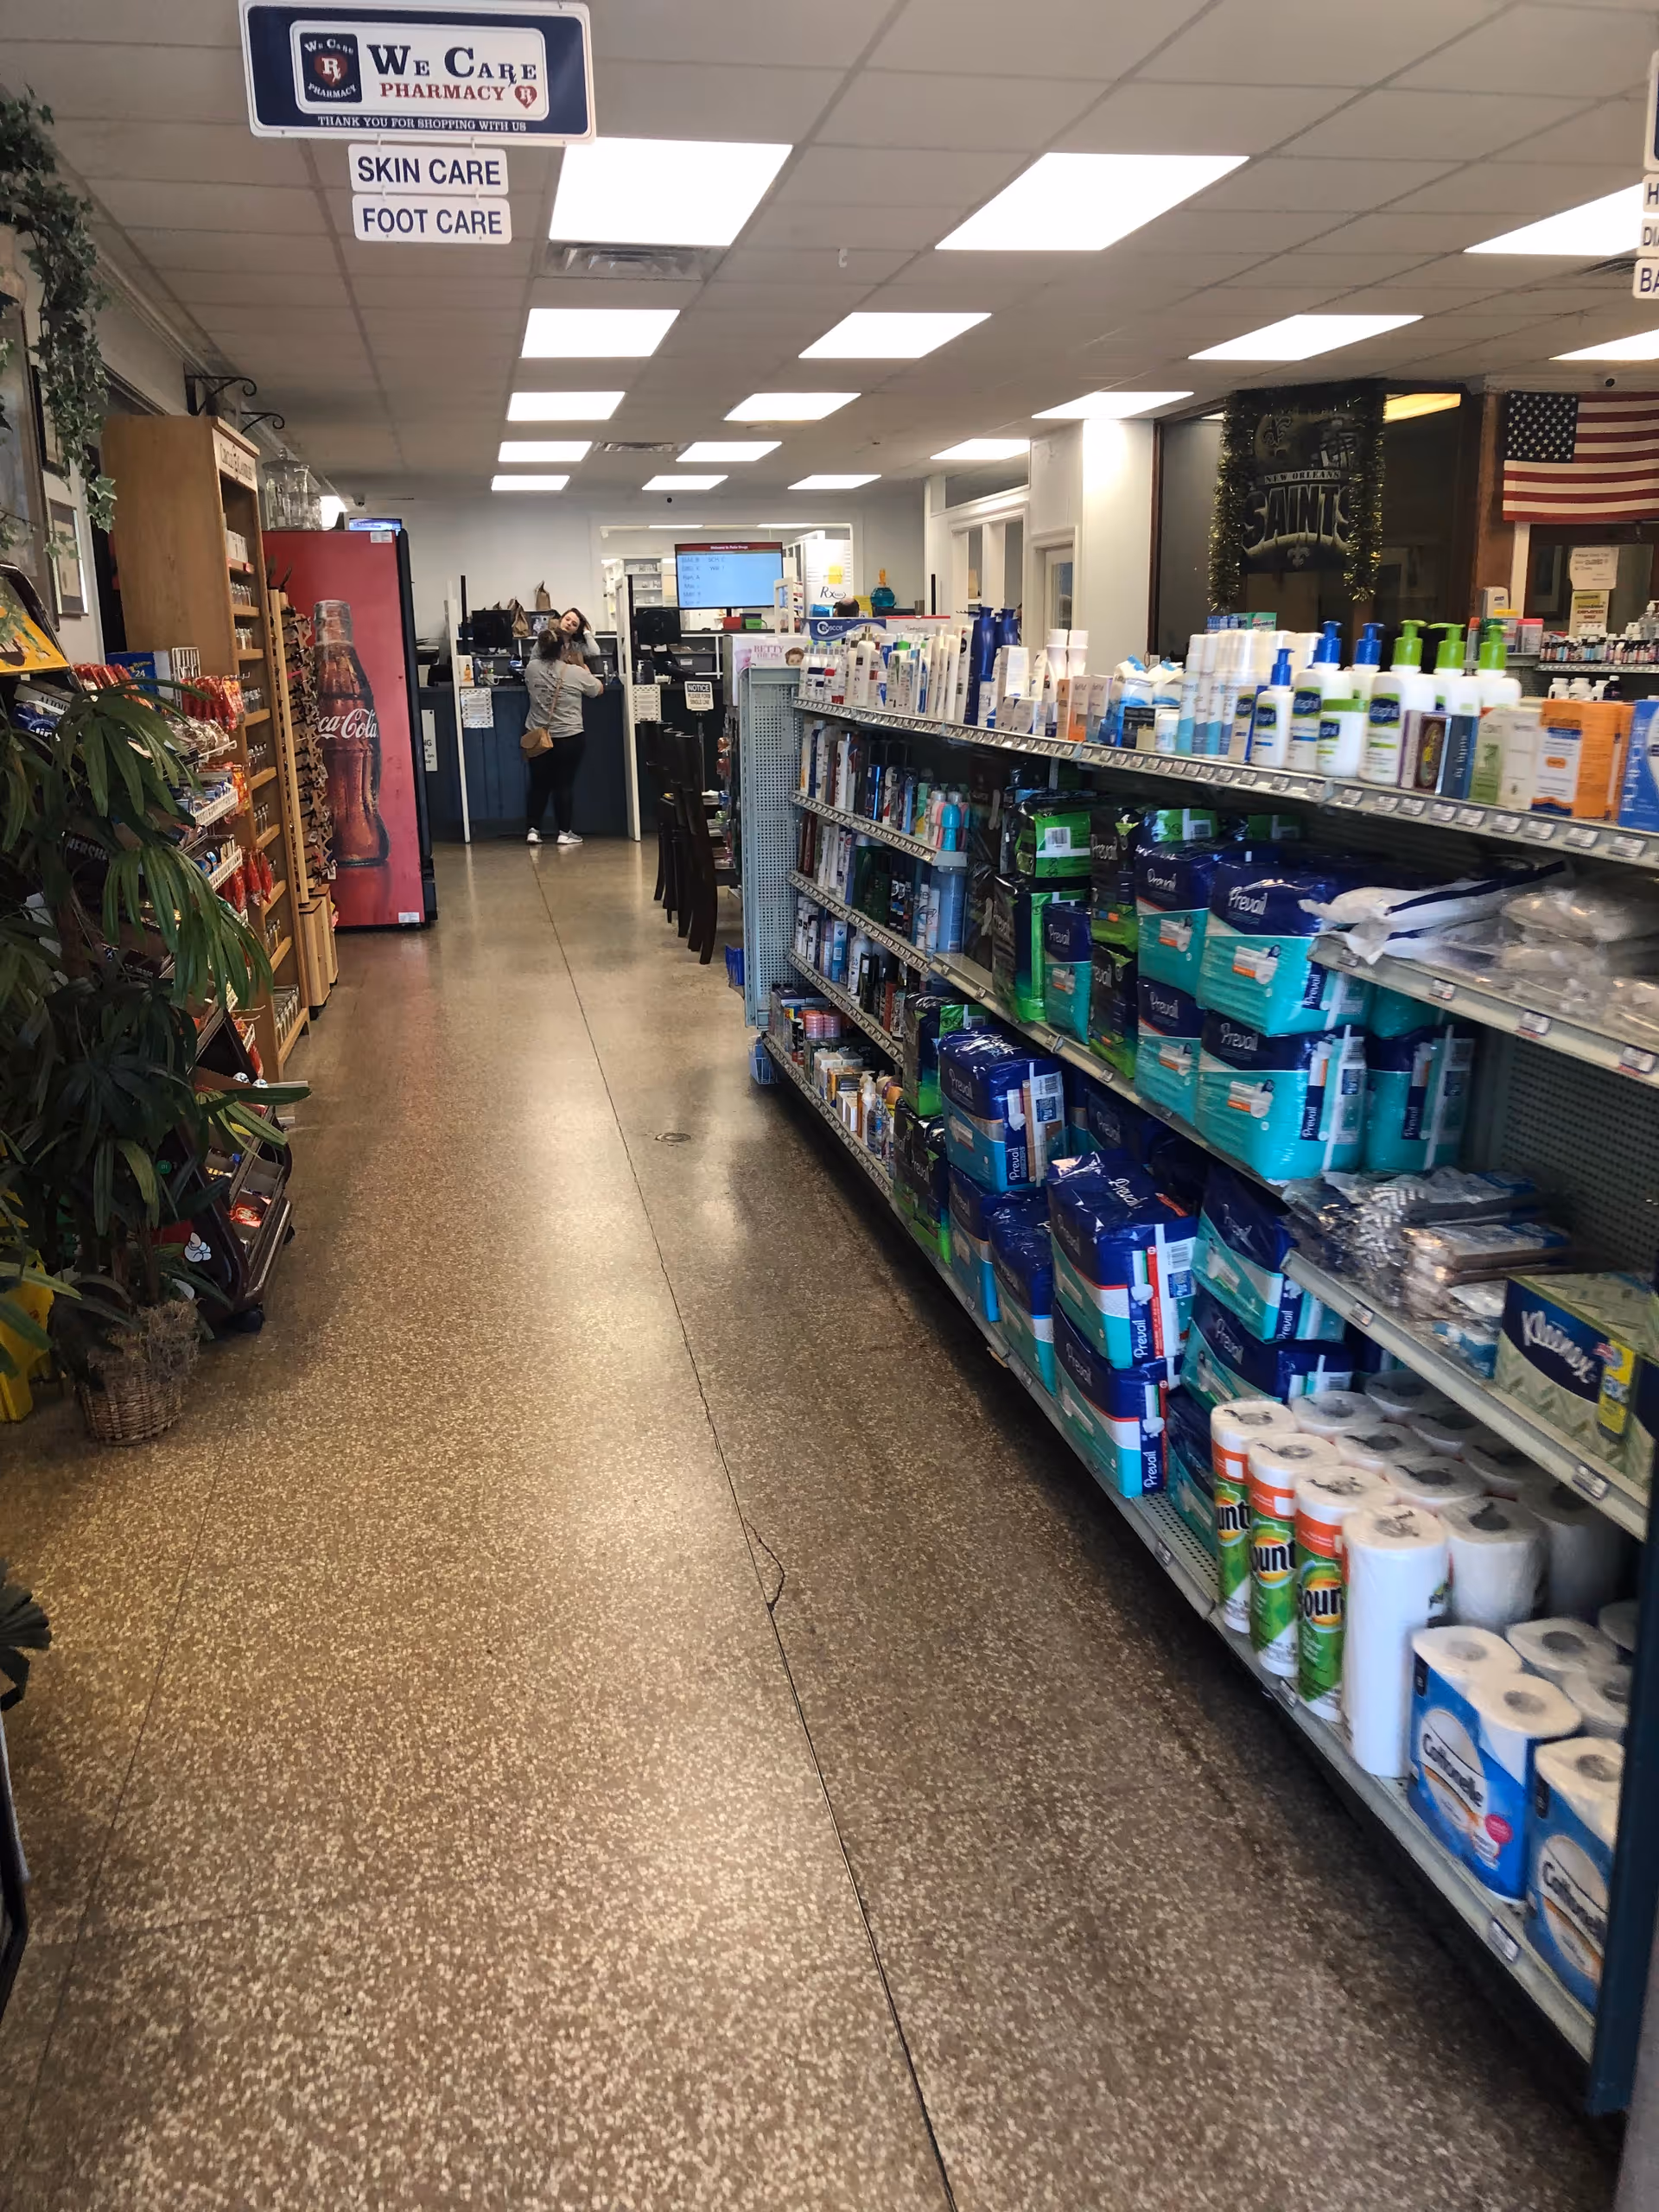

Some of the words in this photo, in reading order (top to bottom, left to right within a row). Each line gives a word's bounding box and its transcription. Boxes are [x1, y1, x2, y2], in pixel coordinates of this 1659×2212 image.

[308, 82, 358, 99] PHARMACY
[379, 82, 506, 101] PHARMACY
[317, 115, 360, 127] THANK
[363, 117, 389, 128] YOU
[391, 118, 416, 129] FOR
[417, 118, 476, 130] SHOPPING
[479, 120, 510, 131] WITH
[512, 121, 527, 131] US
[357, 156, 421, 184] SKIN
[429, 158, 502, 185] CARE
[362, 207, 429, 233] FOOT
[435, 209, 503, 235] CARE
[1265, 474, 1287, 484] NEW
[1292, 470, 1340, 480] ORLEANS
[687, 683, 710, 692] NOTICE
[316, 708, 378, 739] ca-Cola
[1227, 886, 1268, 916] Prevail
[1048, 923, 1071, 946] Prevail
[1092, 963, 1113, 988] revail
[1303, 974, 1321, 1007] Prevail
[1149, 991, 1179, 1020] Prevail
[1219, 1022, 1259, 1052] Prevail
[948, 1067, 974, 1100] Prevail
[1302, 1105, 1319, 1138] Prevail
[1403, 1106, 1419, 1138] Prevail
[1009, 1146, 1020, 1181] Prevail
[1133, 1318, 1147, 1359] Prevail
[1276, 1310, 1294, 1339] Prevail
[1521, 1309, 1598, 1384] Kleenex
[1143, 1449, 1157, 1489] Prevail
[1217, 1500, 1251, 1532] unt
